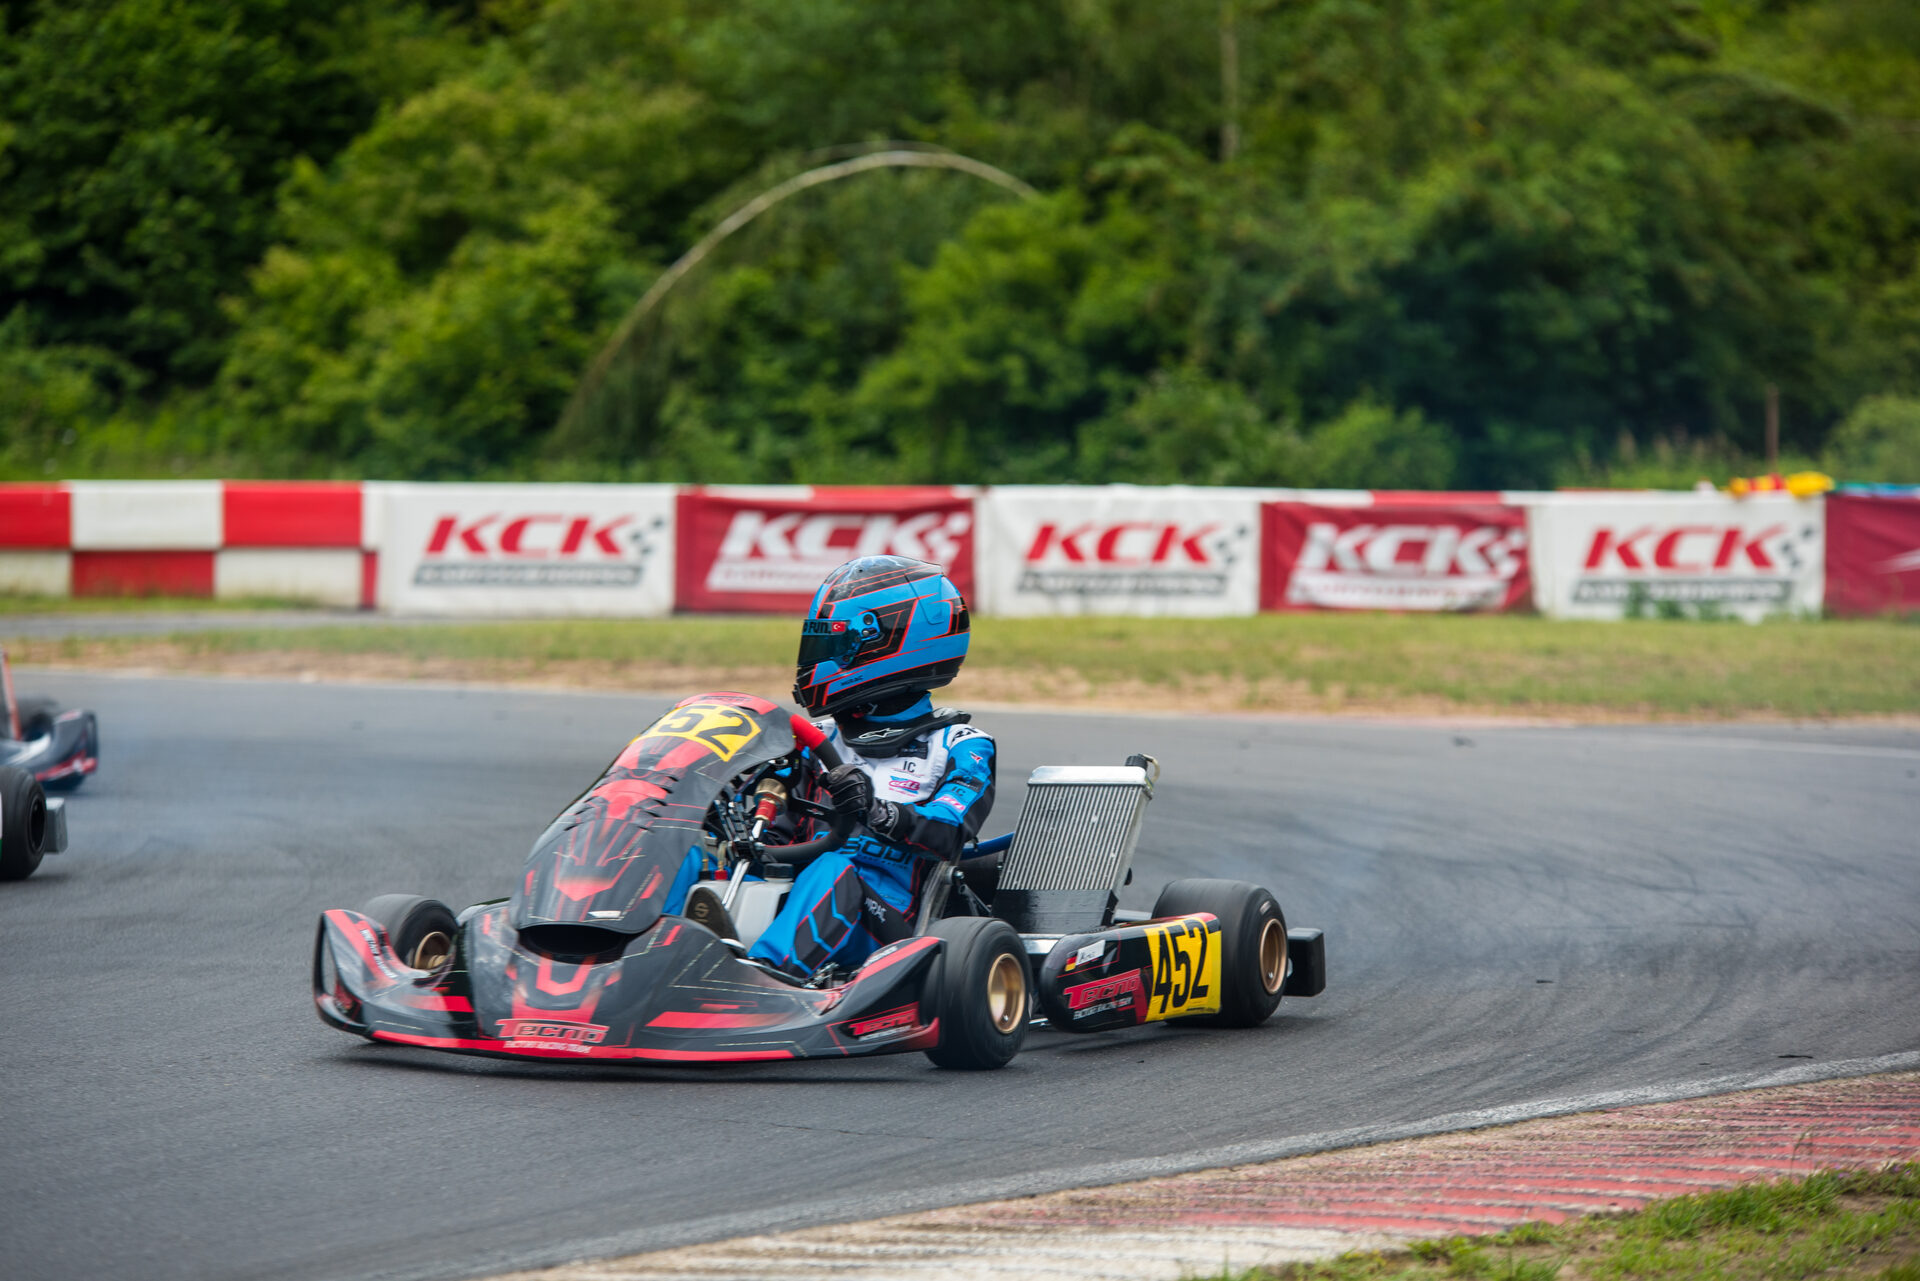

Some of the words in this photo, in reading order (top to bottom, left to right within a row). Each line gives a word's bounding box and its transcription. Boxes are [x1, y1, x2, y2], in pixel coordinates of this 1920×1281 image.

[424, 513, 635, 557] KCK
[719, 511, 943, 560] KCK
[1024, 521, 1222, 564] KCK
[1299, 523, 1496, 574] KCK
[1583, 524, 1784, 572] KCK
[648, 705, 753, 755] 52
[1153, 918, 1209, 1014] 452
